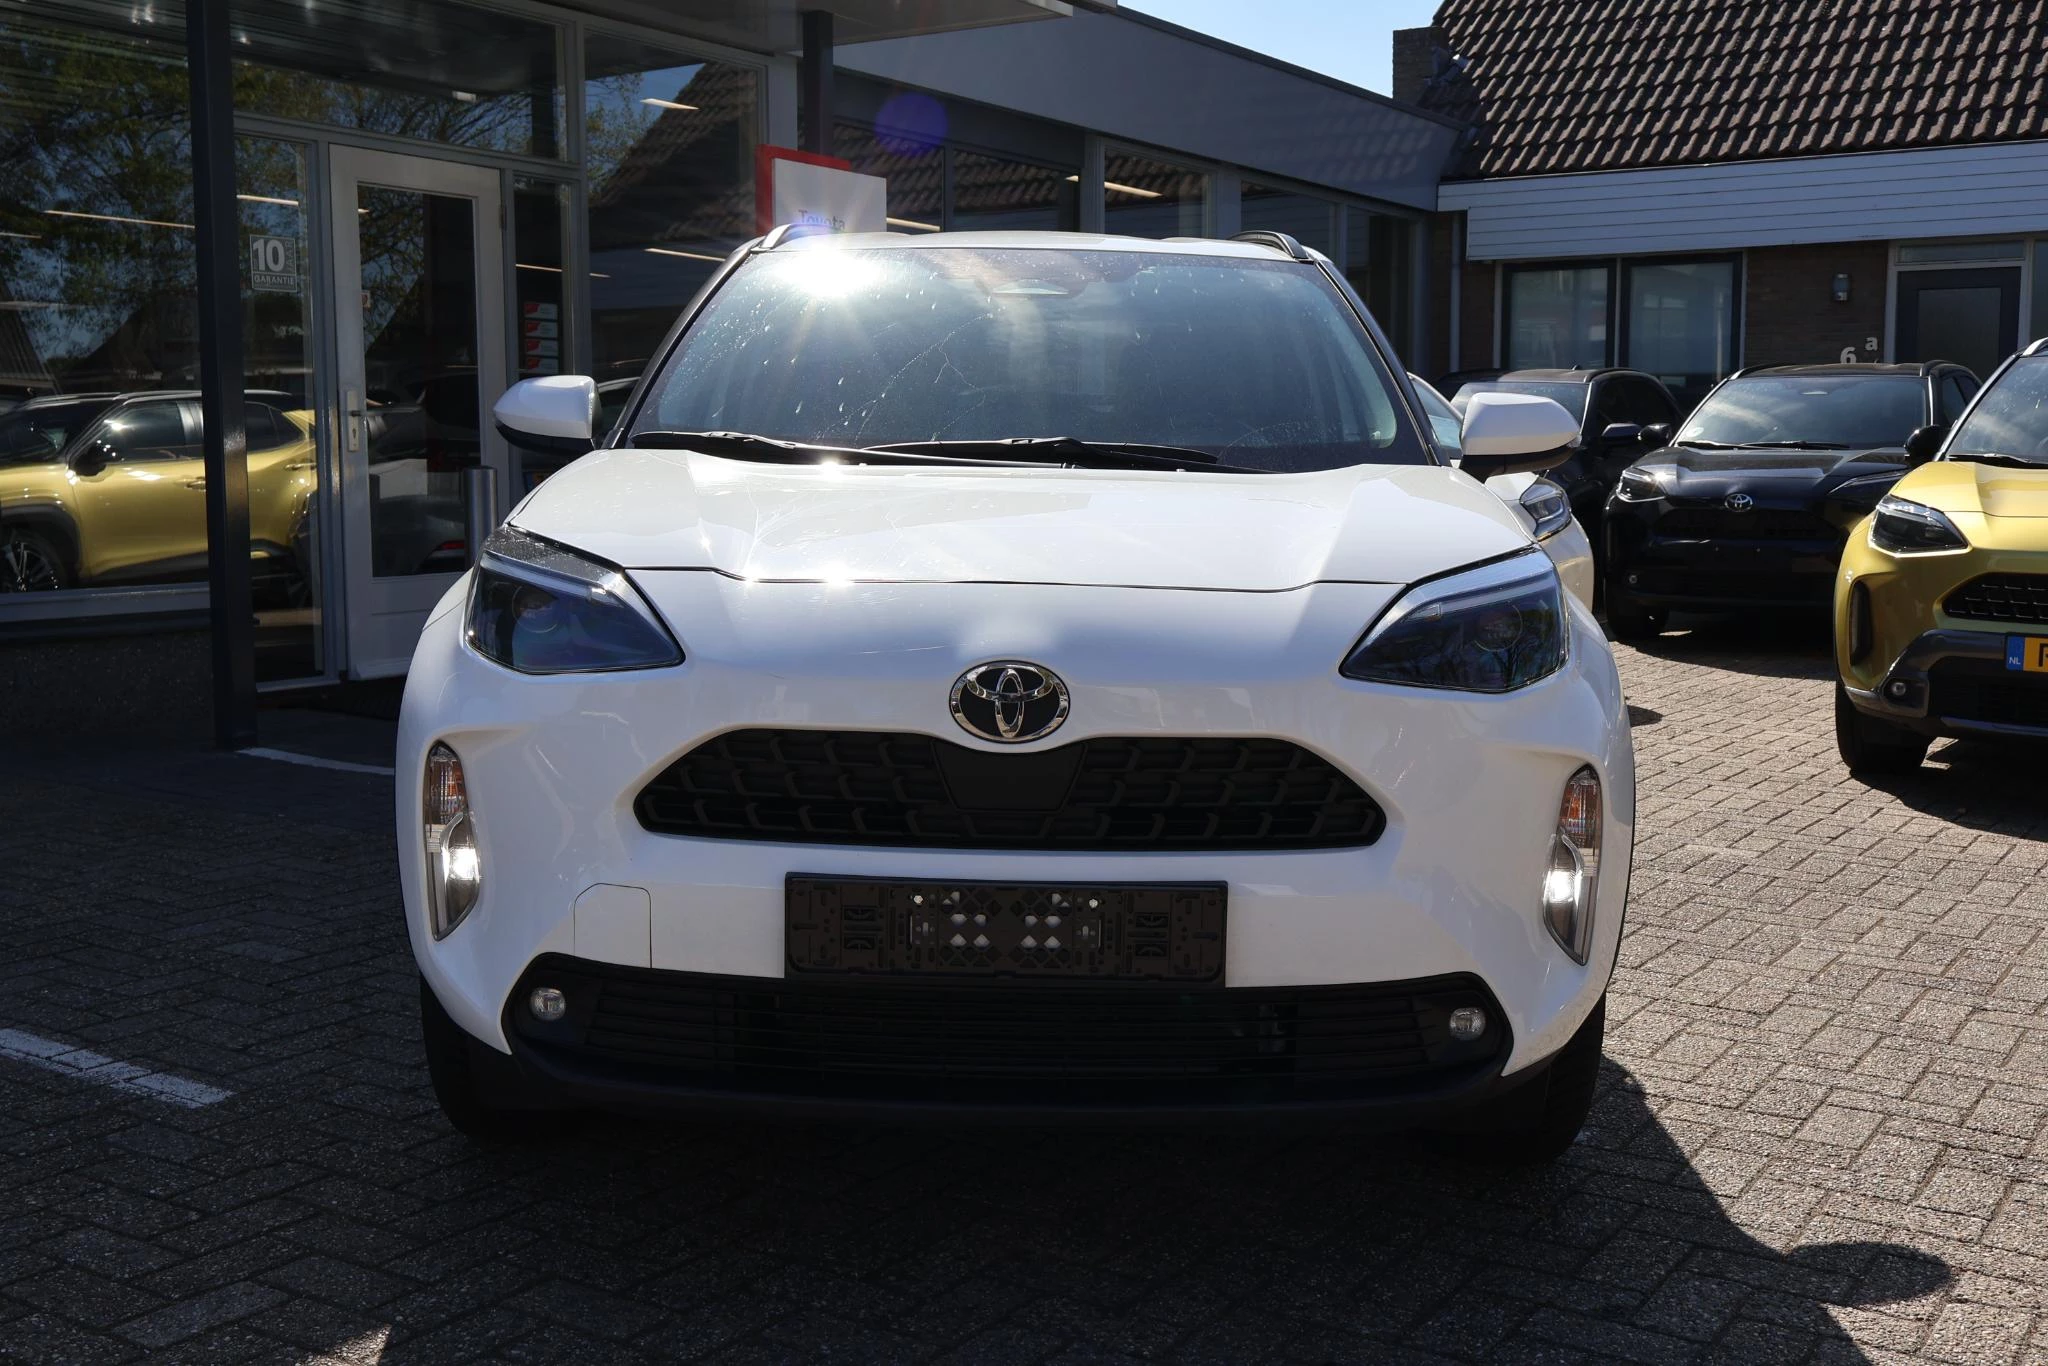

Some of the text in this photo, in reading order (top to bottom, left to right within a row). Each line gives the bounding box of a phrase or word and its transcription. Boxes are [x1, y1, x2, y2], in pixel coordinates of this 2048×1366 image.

[253, 238, 285, 272] 10
[254, 274, 295, 285] GARANTIE
[2008, 656, 2021, 665] NL
